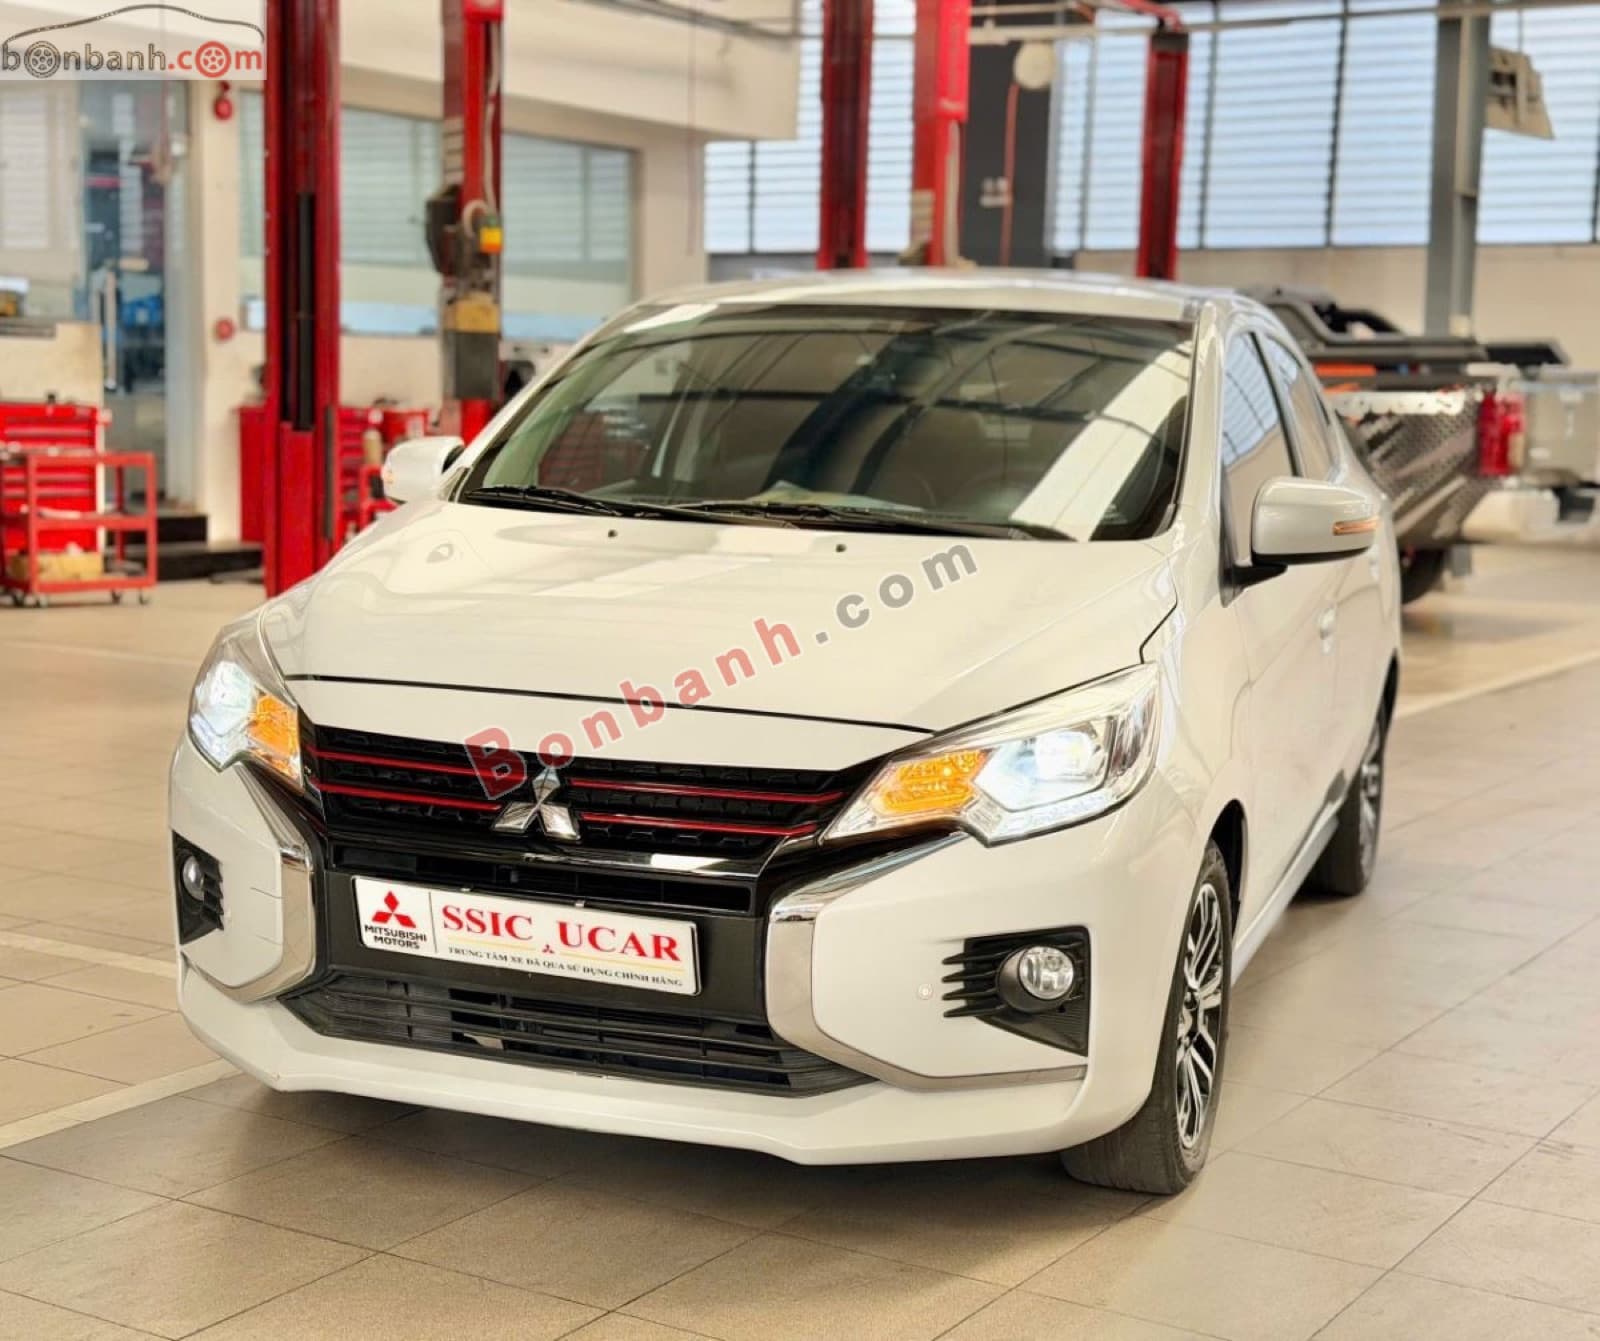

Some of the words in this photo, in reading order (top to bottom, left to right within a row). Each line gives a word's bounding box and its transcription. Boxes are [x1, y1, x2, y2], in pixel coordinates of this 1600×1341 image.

[364, 924, 427, 942] MITSUBISHI
[373, 935, 420, 950] MOTORS
[442, 904, 534, 941] SSIC
[556, 920, 682, 962] UCAR
[448, 946, 483, 958] TRUNG
[486, 950, 508, 963] TÂM
[510, 955, 524, 965] XE
[543, 959, 566, 971] QUA
[583, 965, 613, 977] DỤNG
[614, 969, 650, 983] CHÍNH
[651, 974, 683, 987] HÀNG
